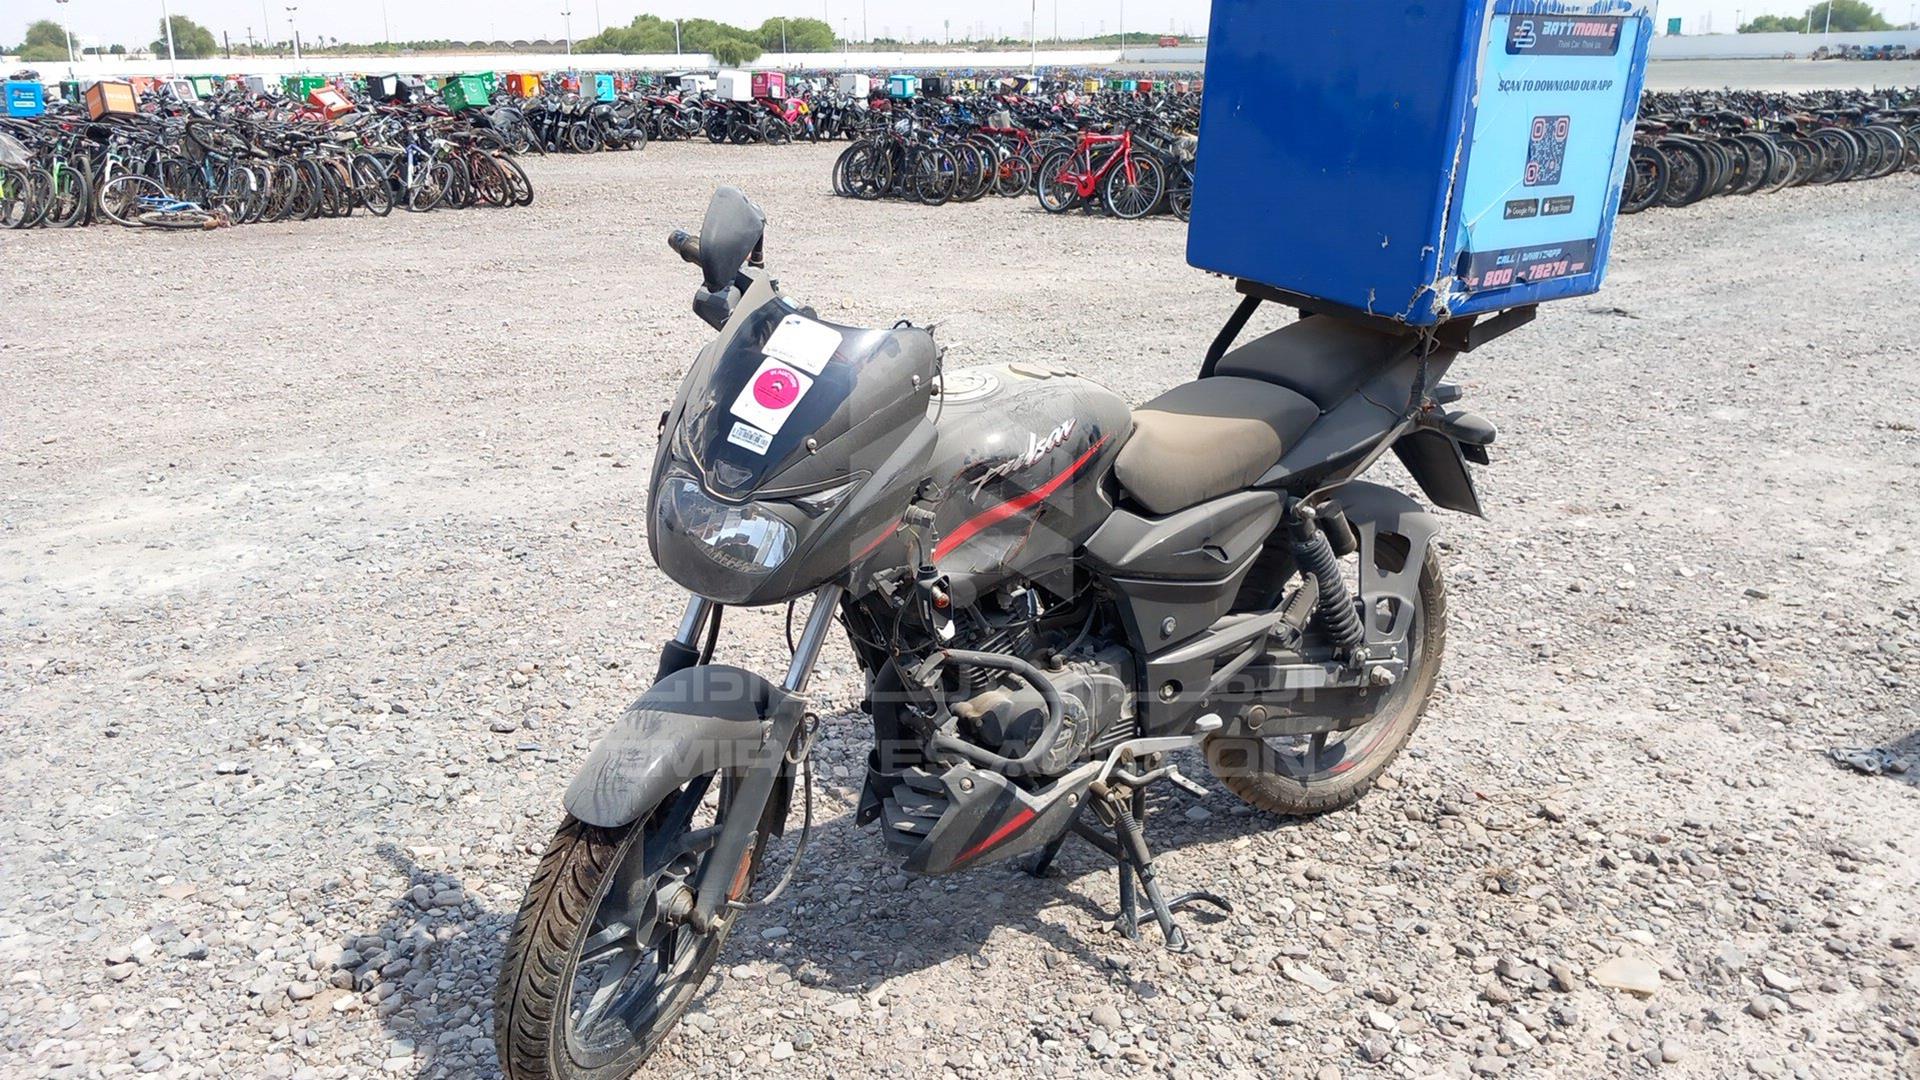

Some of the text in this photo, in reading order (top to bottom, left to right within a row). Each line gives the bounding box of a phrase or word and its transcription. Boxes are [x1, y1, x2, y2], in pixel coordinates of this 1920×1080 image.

[1542, 21, 1618, 37] BATTMOBILE
[1498, 79, 1613, 92] SCAN TO DOWNLOAD OUR APP
[1496, 256, 1515, 265] CALL
[1484, 269, 1512, 286] 800
